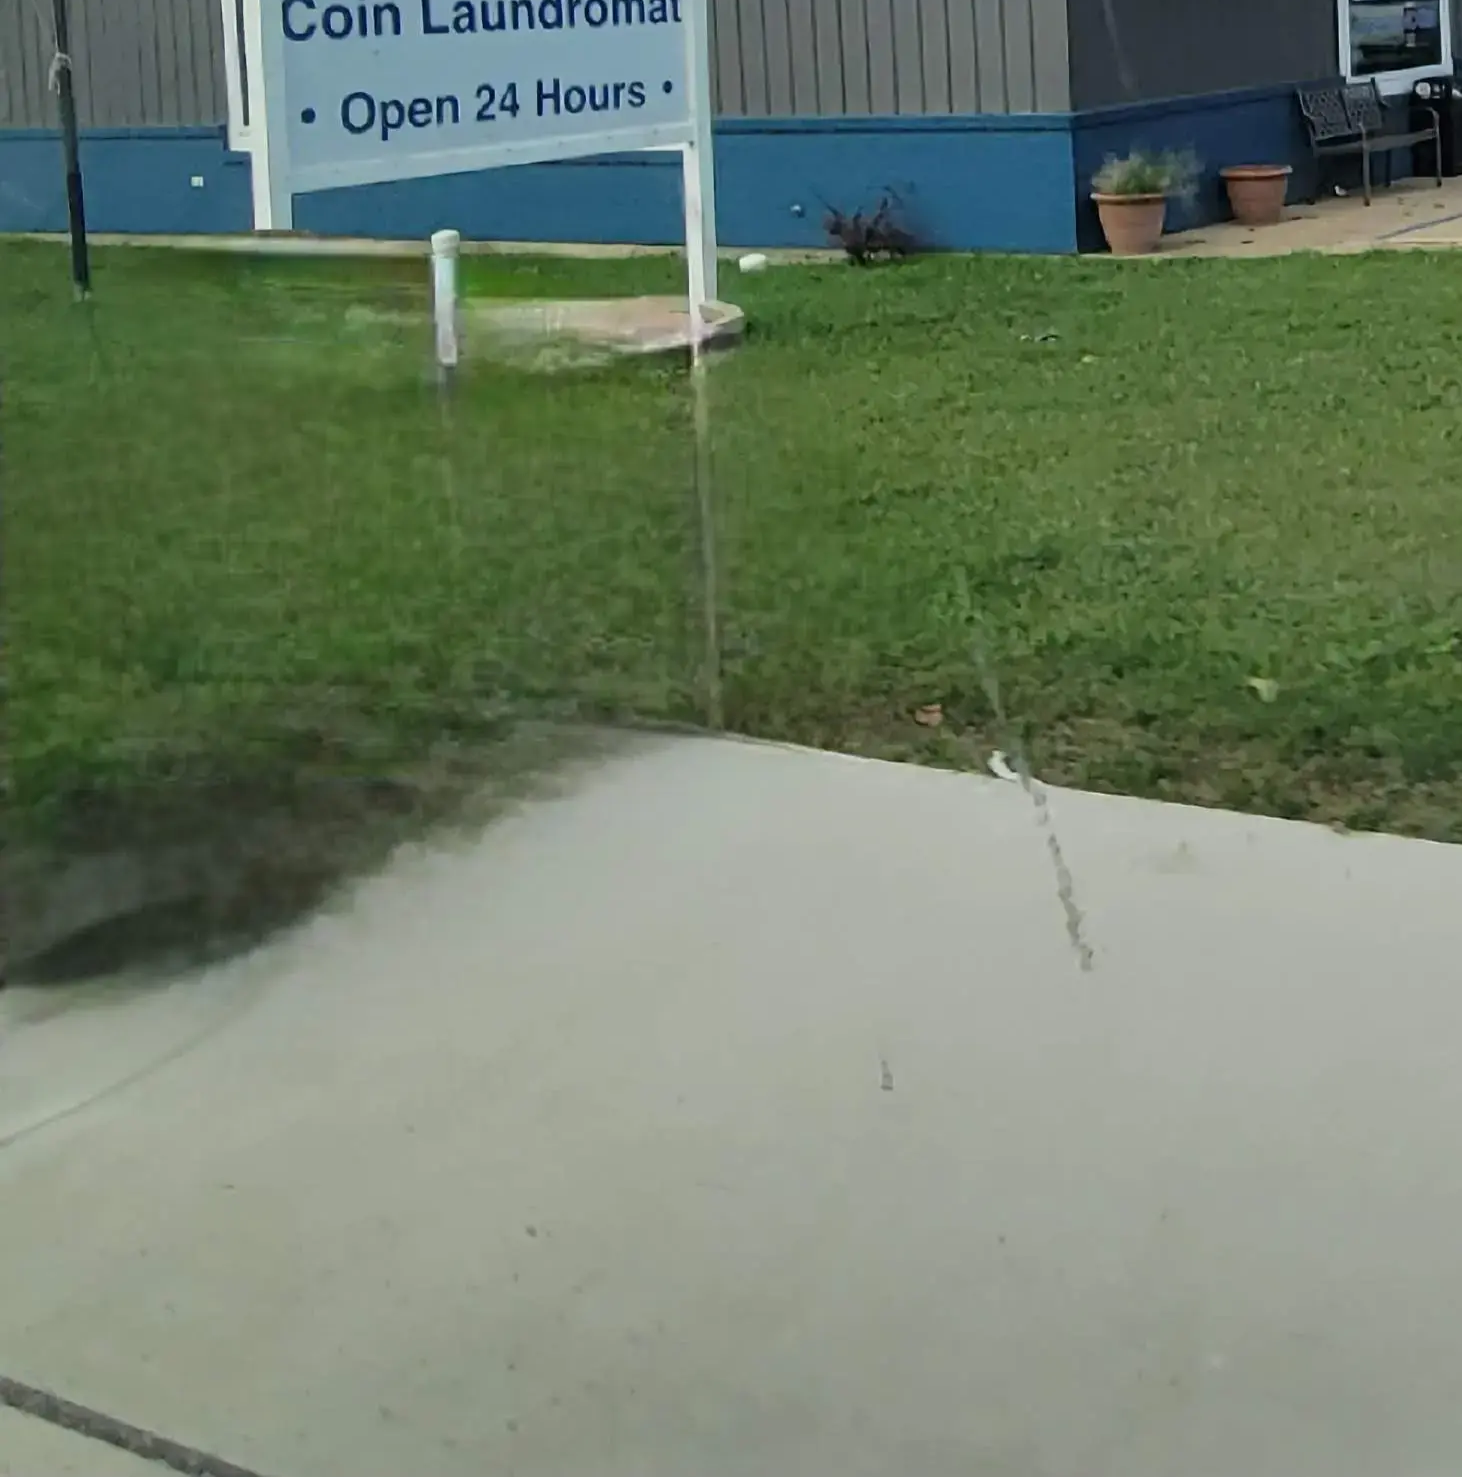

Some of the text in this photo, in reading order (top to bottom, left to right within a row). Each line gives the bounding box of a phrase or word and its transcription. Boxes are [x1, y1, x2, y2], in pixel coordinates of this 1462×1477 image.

[341, 78, 646, 141] Open 24 Hours
